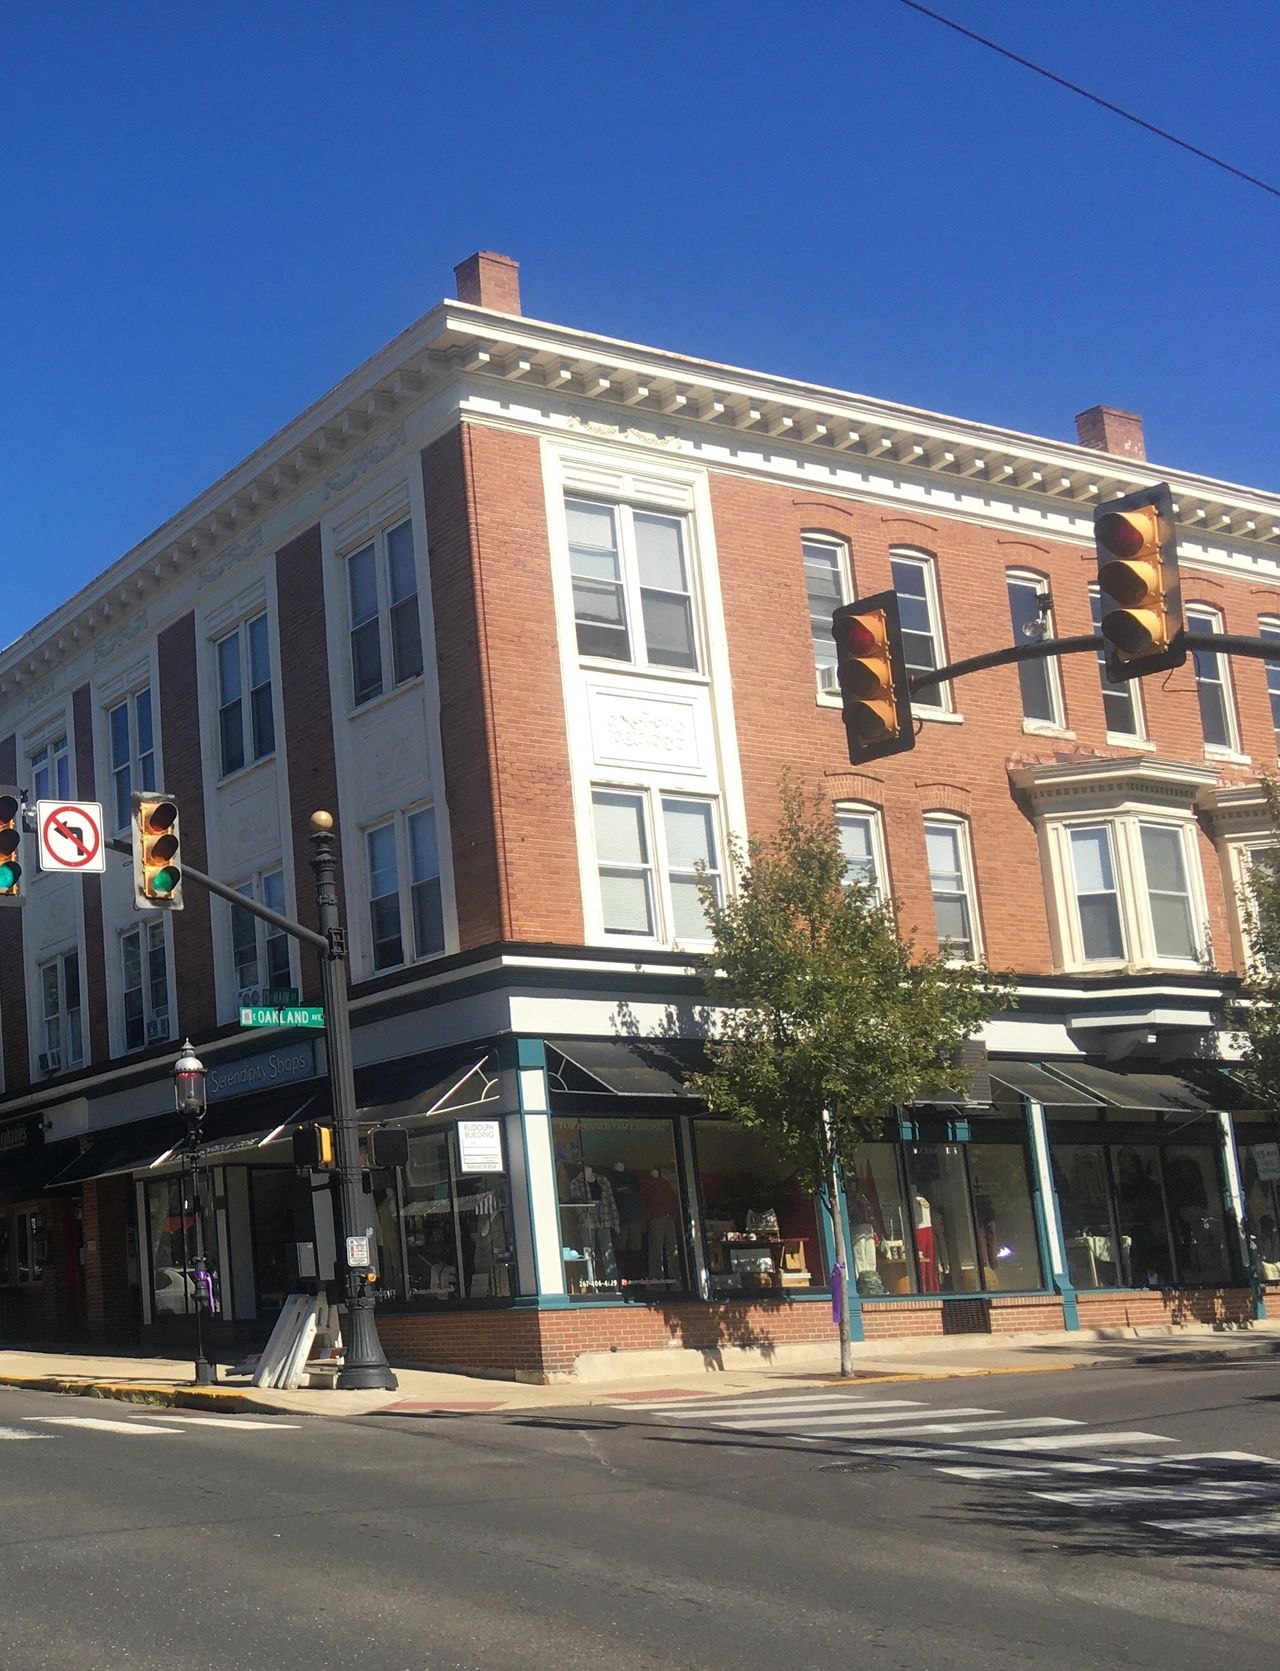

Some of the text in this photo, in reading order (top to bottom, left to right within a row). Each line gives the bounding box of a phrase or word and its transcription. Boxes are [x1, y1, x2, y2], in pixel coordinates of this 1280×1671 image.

[258, 1010, 309, 1024] OAKLAND
[211, 1054, 305, 1093] Serendipity Shops
